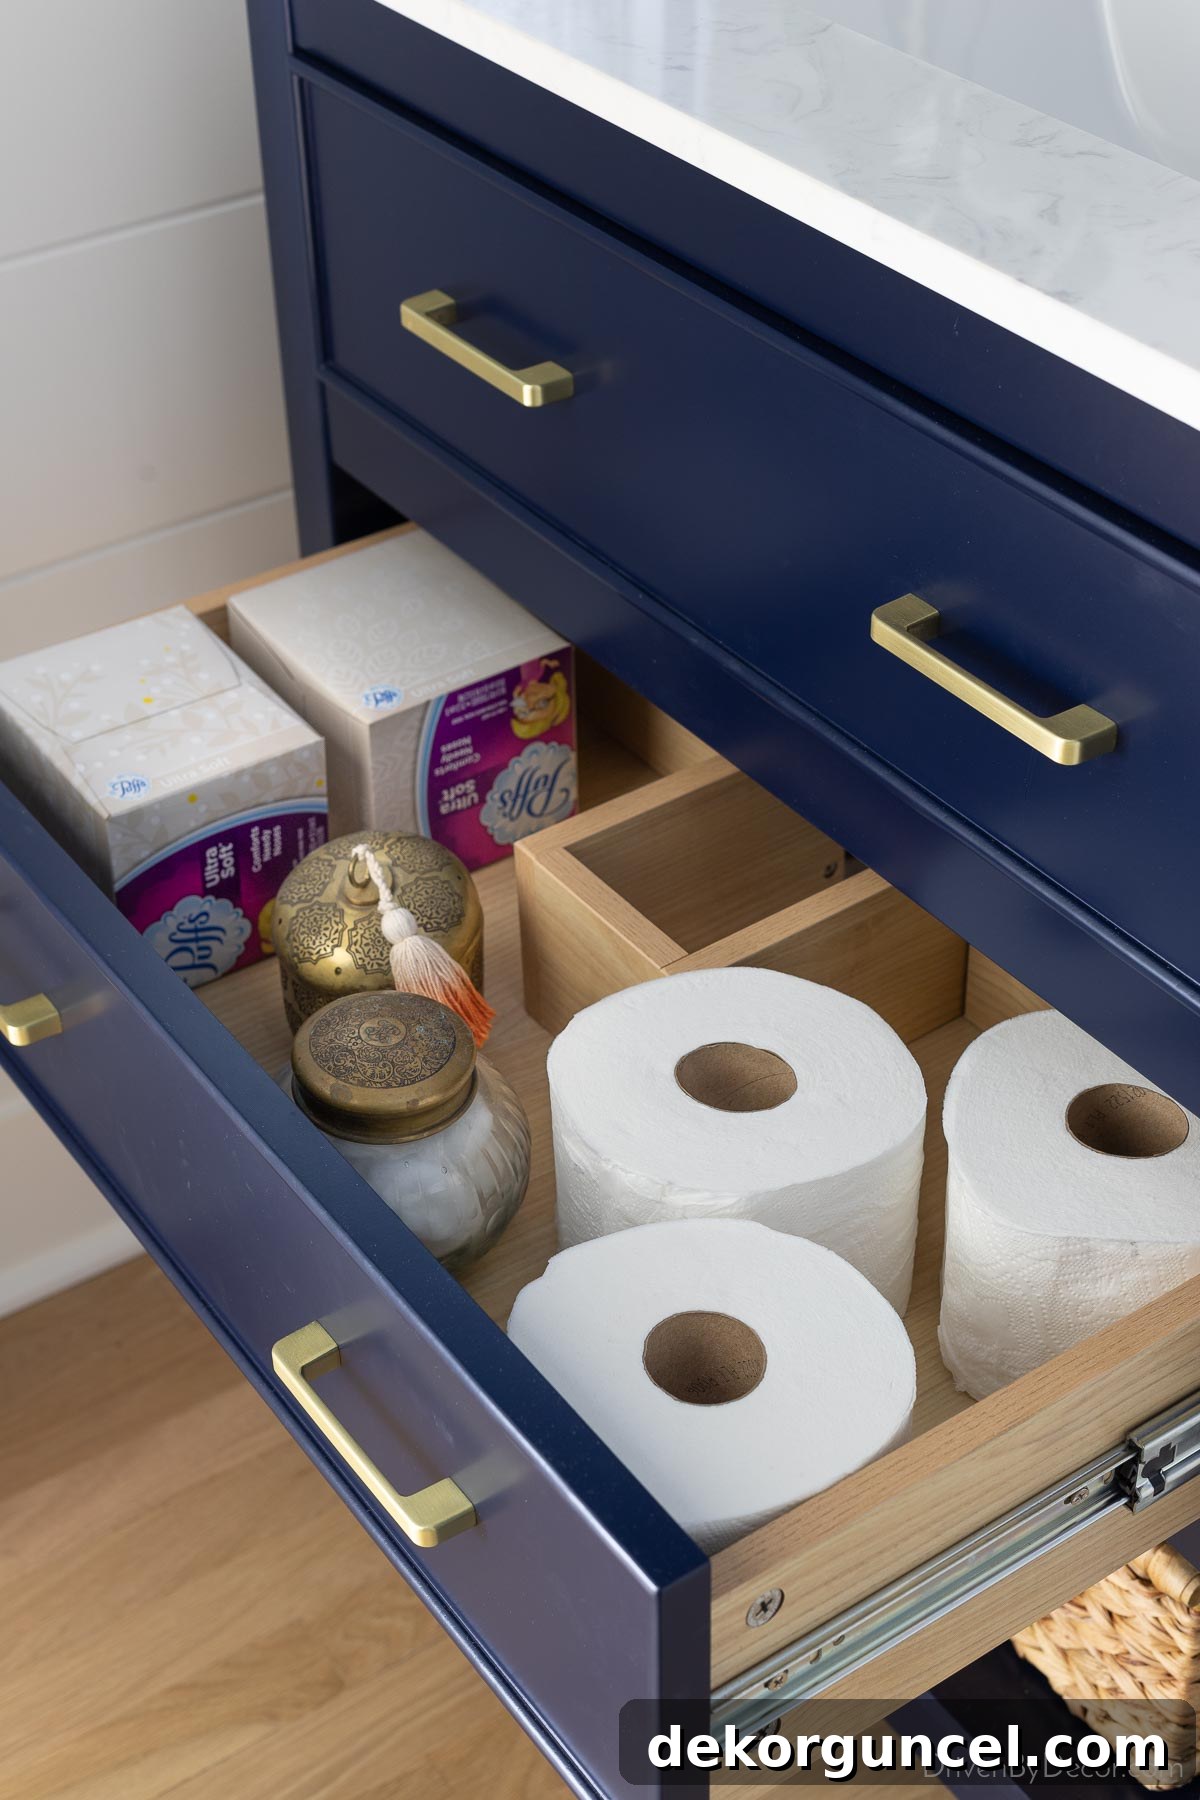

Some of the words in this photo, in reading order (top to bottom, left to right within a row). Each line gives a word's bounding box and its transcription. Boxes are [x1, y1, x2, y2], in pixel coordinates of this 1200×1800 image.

[434, 753, 480, 776] Comforts
[111, 778, 147, 798] Puffs
[439, 793, 478, 815] Ultra
[441, 779, 476, 801] Soft
[499, 758, 571, 821] Puffs
[205, 845, 220, 888] Ultra
[219, 842, 235, 879] Soft
[251, 826, 262, 873] Comforts
[165, 911, 226, 984] Puffs
